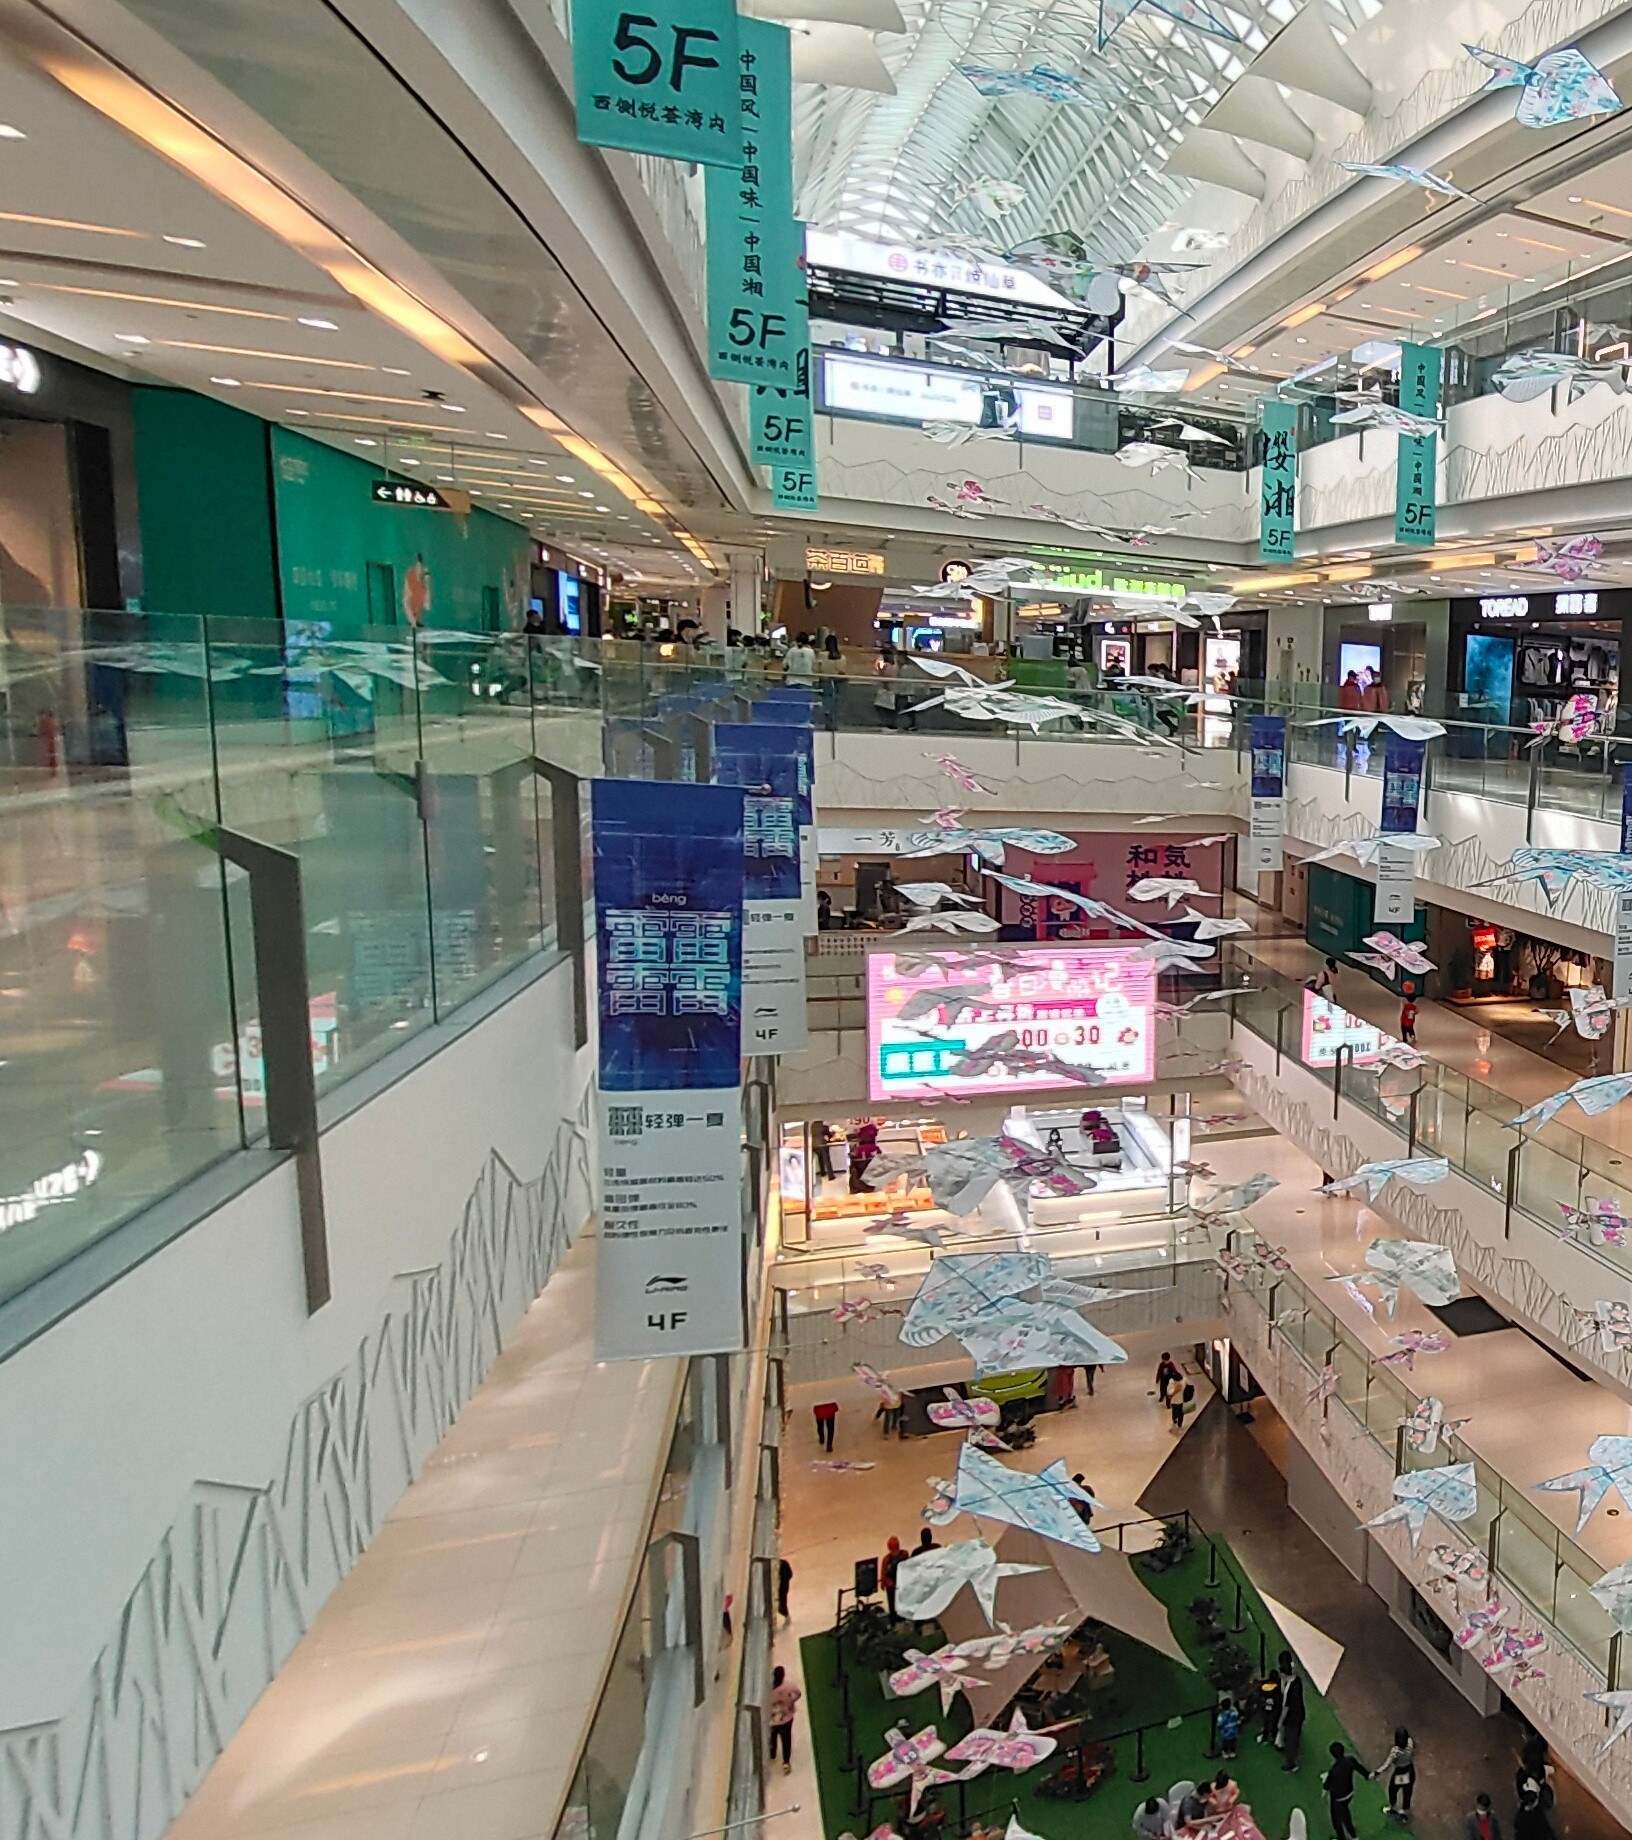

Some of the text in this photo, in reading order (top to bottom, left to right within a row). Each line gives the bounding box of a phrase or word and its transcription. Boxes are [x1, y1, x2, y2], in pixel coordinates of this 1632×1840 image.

[611, 13, 719, 92] 5F
[592, 94, 725, 134] 西侧悦荟湾内
[728, 308, 786, 349] 5F
[763, 415, 803, 442] 5F
[782, 471, 812, 492] 5F
[1404, 503, 1431, 525] 5F
[1267, 529, 1290, 546] 5F
[1479, 597, 1528, 617] TOREAD
[755, 1028, 778, 1040] 4F
[648, 1312, 687, 1331] 4F
